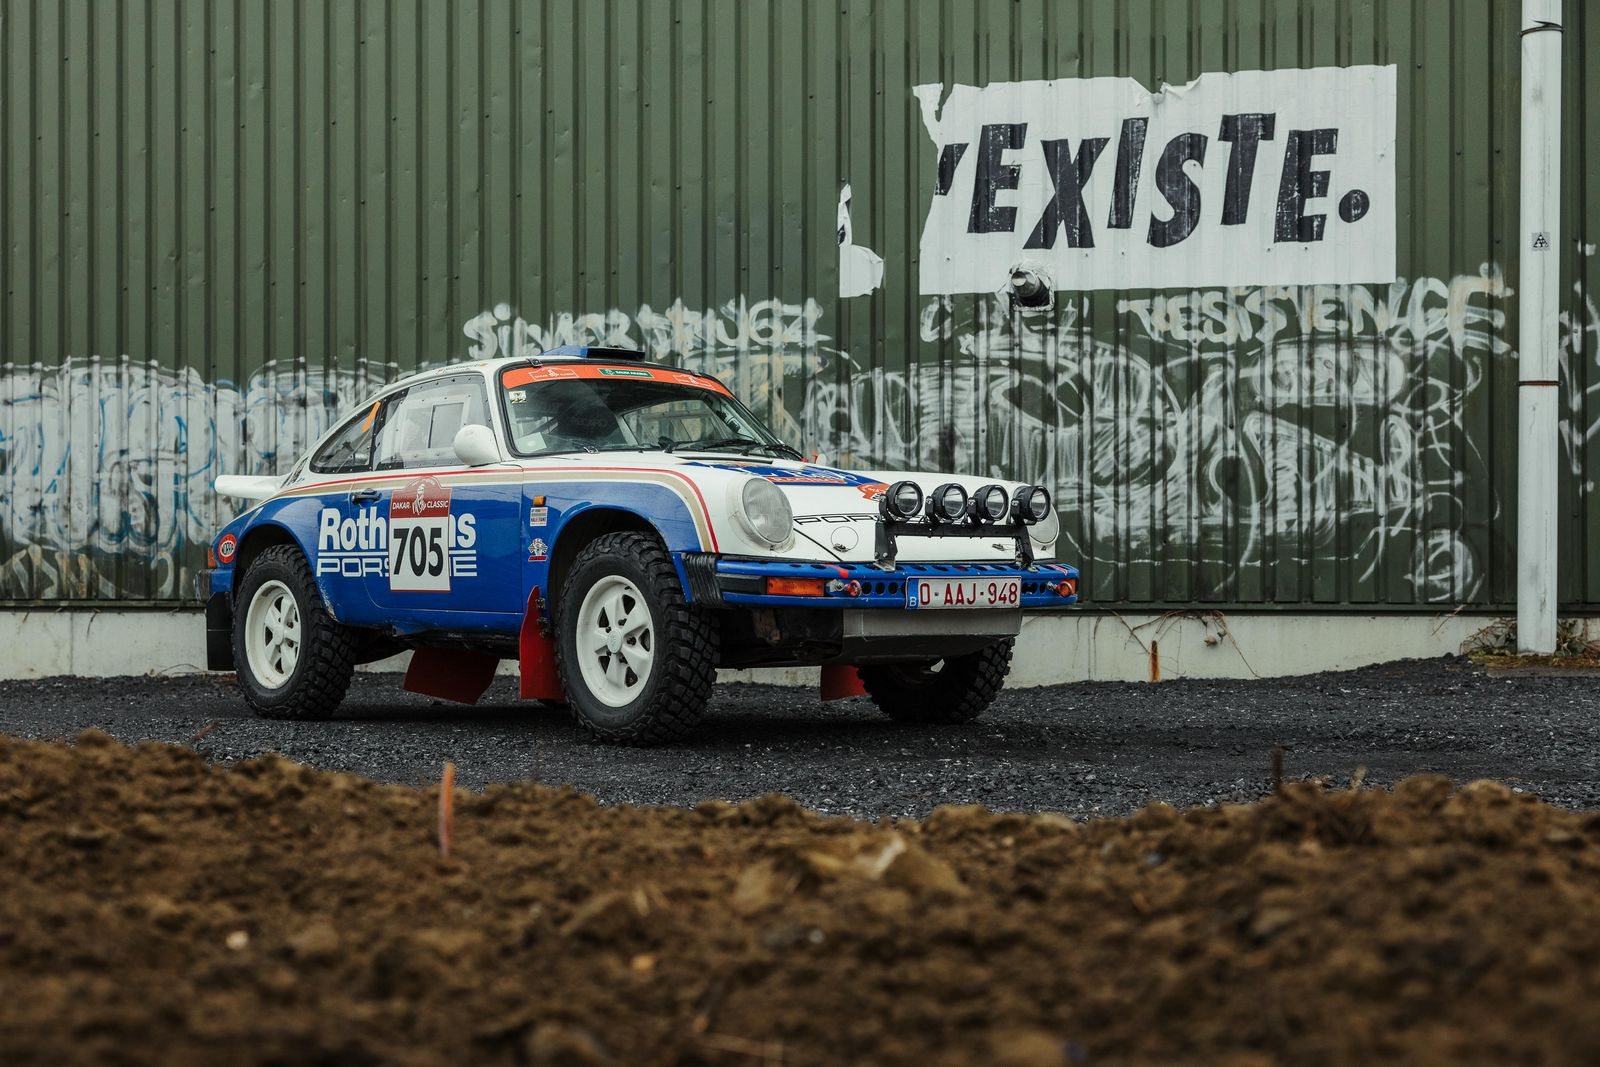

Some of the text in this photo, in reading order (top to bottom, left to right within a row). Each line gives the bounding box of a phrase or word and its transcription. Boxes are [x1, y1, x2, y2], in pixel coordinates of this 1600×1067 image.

[392, 500, 449, 510] DAKAR CLASSIC
[393, 526, 443, 577] 705
[909, 596, 917, 607] B
